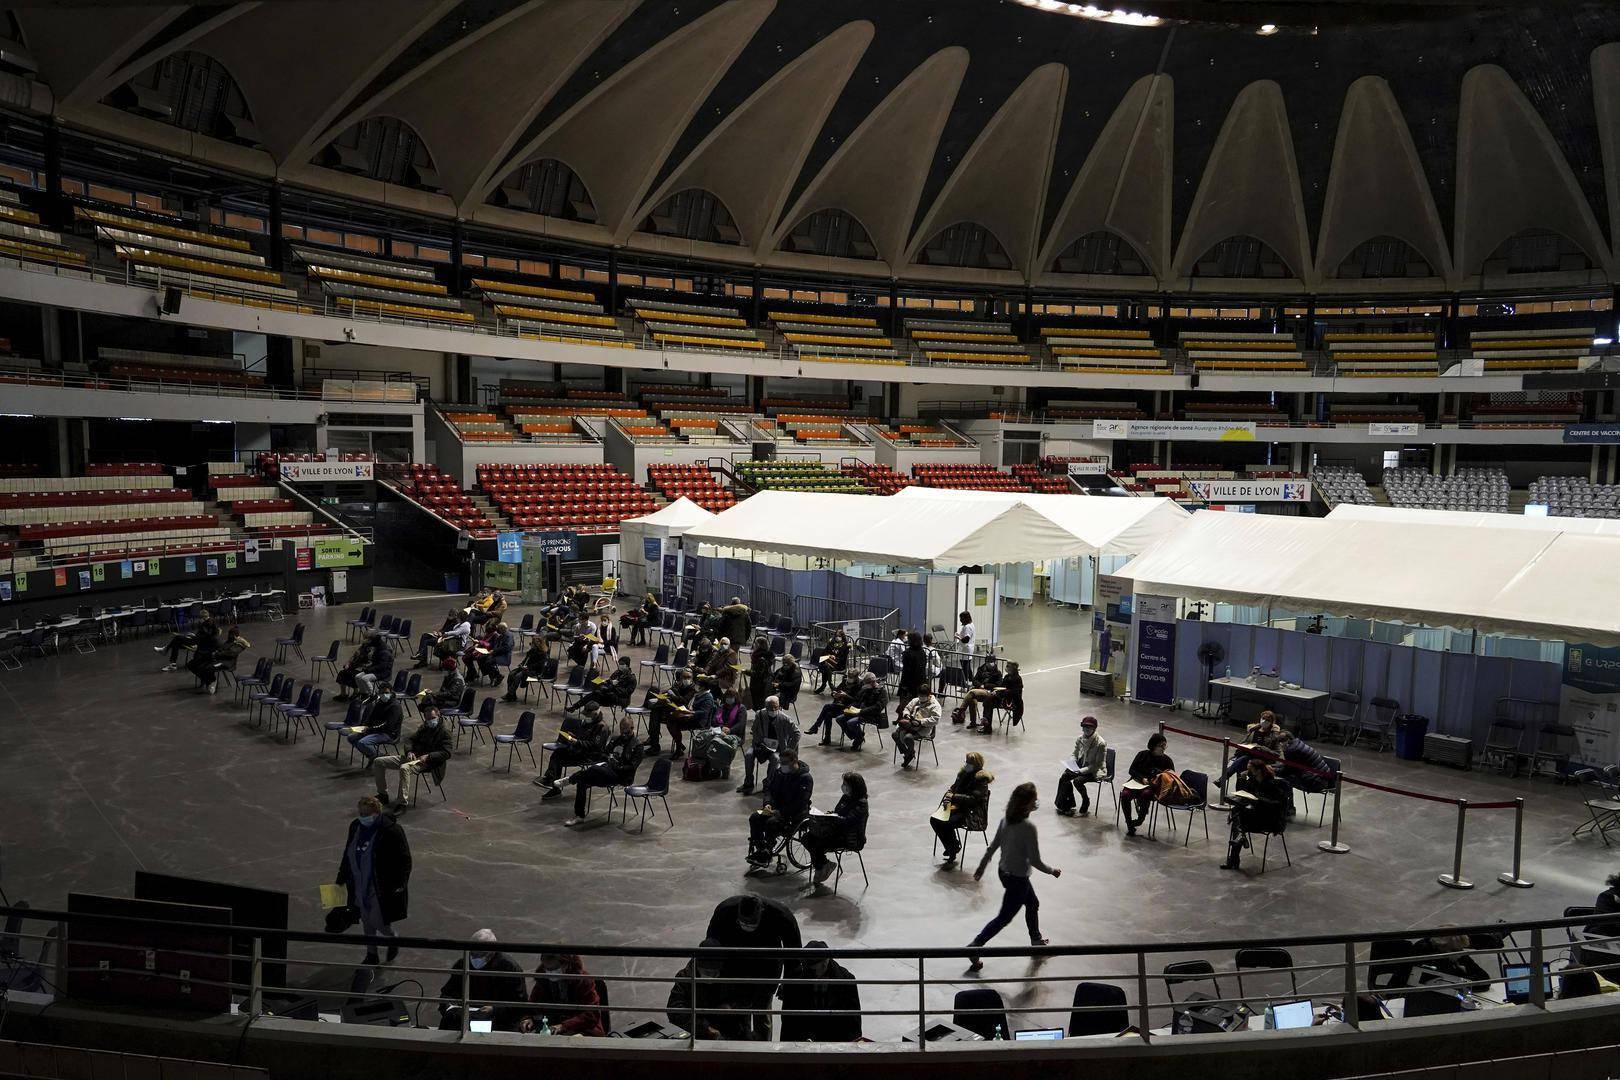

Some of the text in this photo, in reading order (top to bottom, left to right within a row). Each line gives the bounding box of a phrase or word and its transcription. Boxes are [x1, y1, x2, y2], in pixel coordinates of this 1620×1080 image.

[302, 467, 320, 475] VILLE
[323, 467, 332, 475] DE
[1213, 486, 1279, 495] VILLE DE LYON
[502, 541, 519, 549] HCL
[226, 556, 235, 564] 20
[318, 553, 345, 561] PARKING
[149, 562, 158, 570] 19
[94, 567, 103, 576] 18
[17, 577, 26, 585] 17
[1140, 653, 1159, 661] Centre
[1139, 664, 1170, 673] vaccination
[1139, 673, 1166, 682] COVID-19
